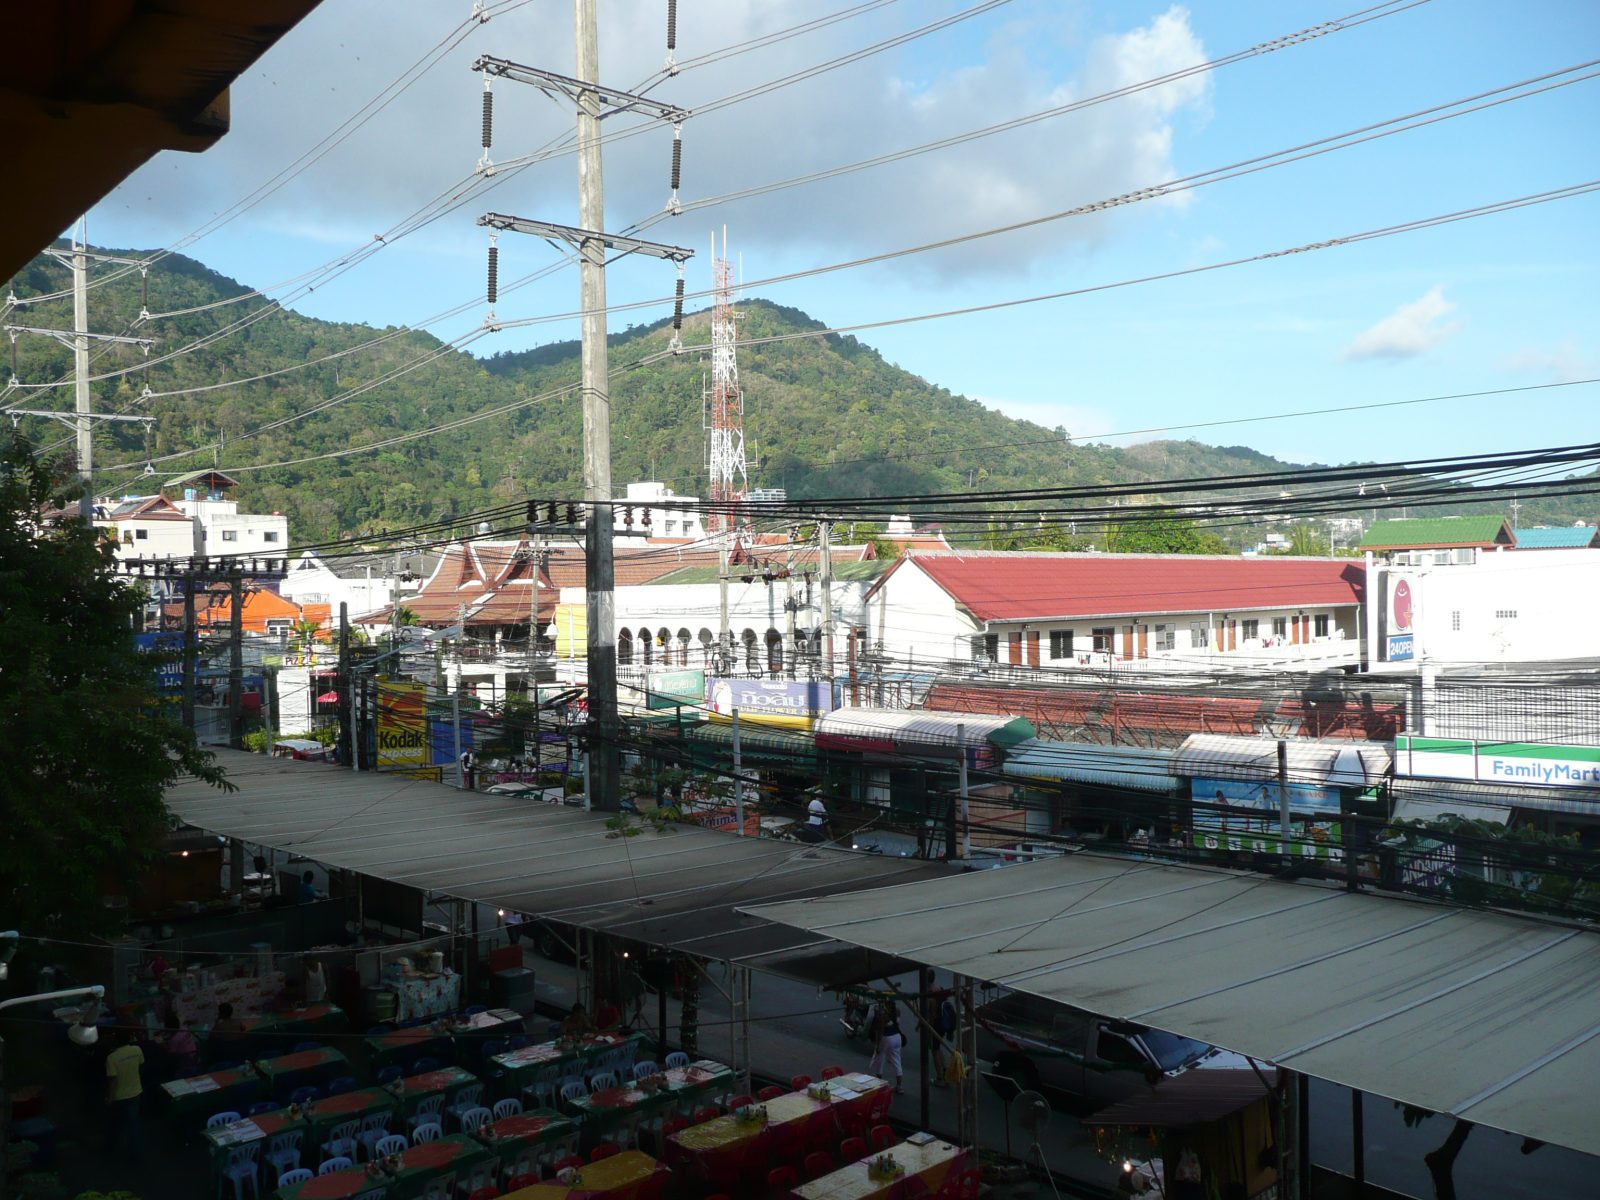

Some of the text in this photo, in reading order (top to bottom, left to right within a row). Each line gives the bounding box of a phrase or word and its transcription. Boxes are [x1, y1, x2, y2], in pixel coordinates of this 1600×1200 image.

[380, 731, 423, 749] Kodak
[380, 748, 424, 760] express
[1493, 760, 1600, 782] FamilyMart
